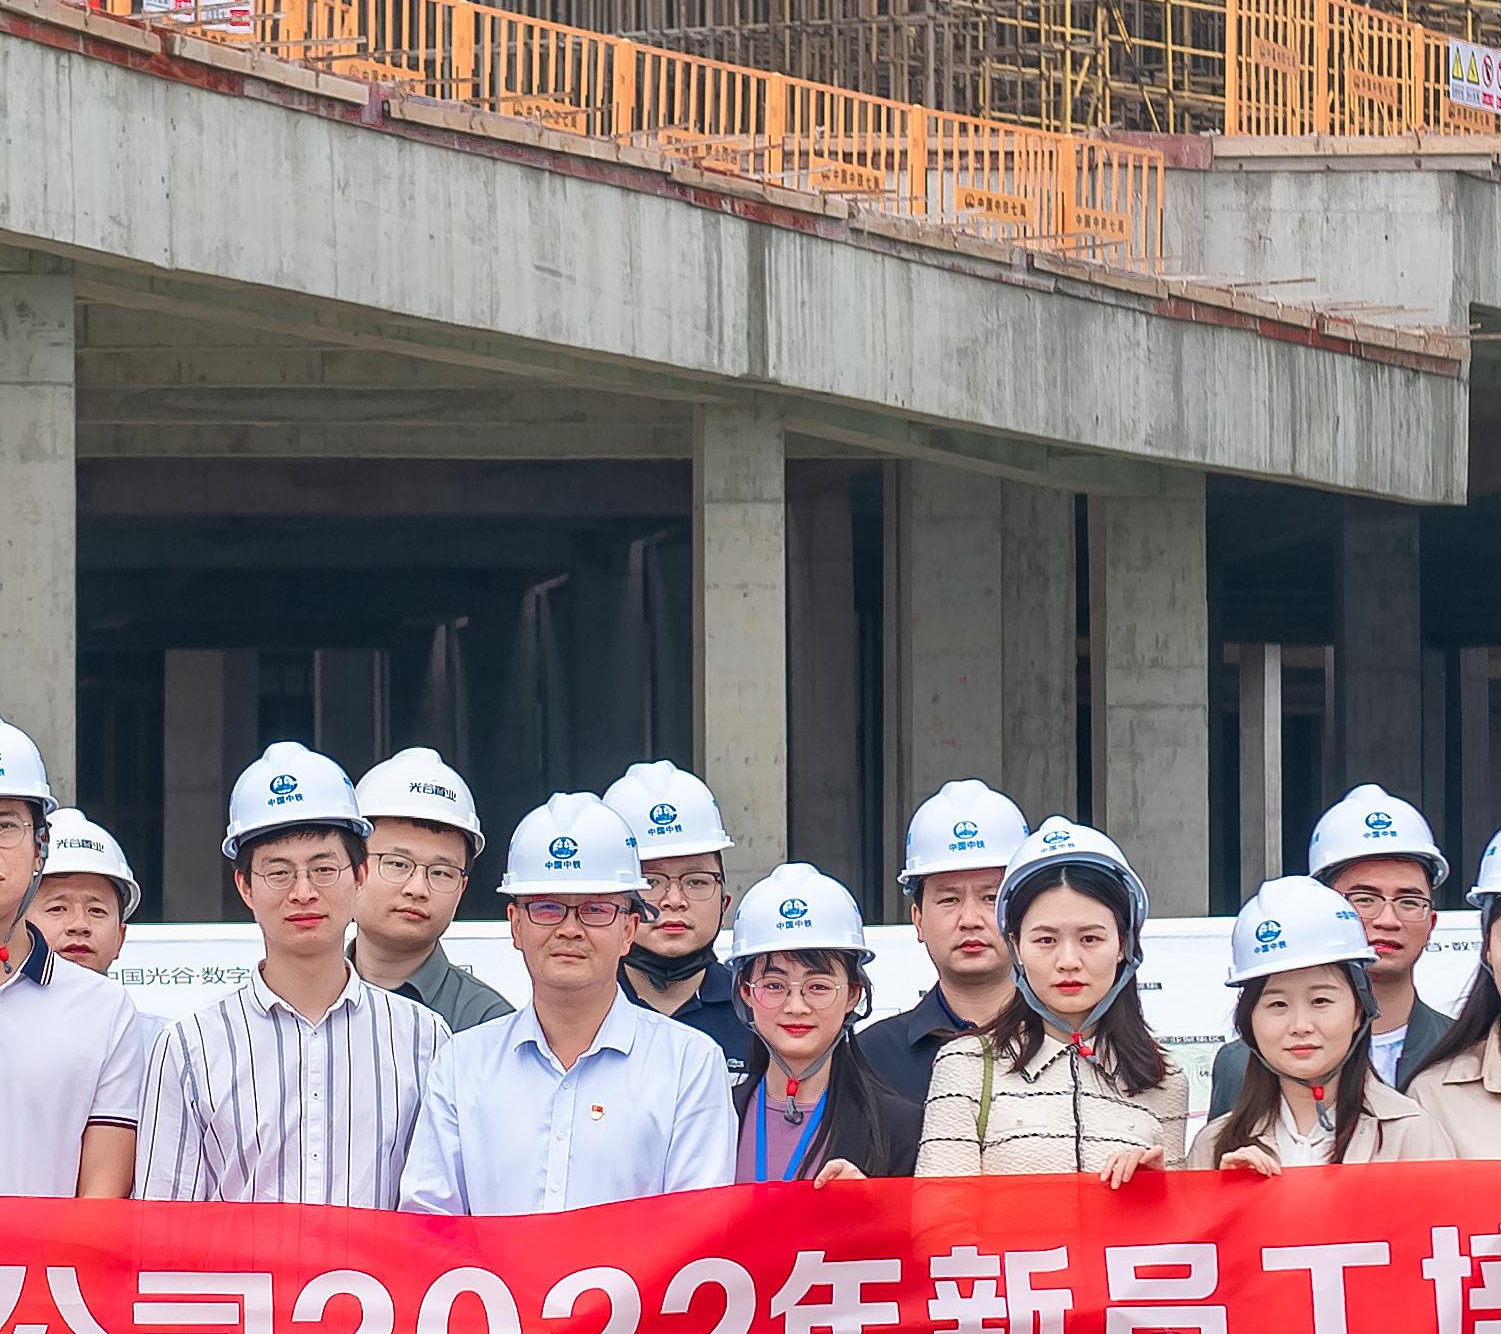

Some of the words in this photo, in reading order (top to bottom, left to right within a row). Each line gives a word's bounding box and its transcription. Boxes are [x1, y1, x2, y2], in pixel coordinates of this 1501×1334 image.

[408, 782, 457, 802] 光谷置业
[267, 793, 304, 807] 中国中铁
[647, 824, 683, 836] 中国中铁
[948, 839, 985, 852] 中国中铁
[544, 859, 582, 870] 中国中铁
